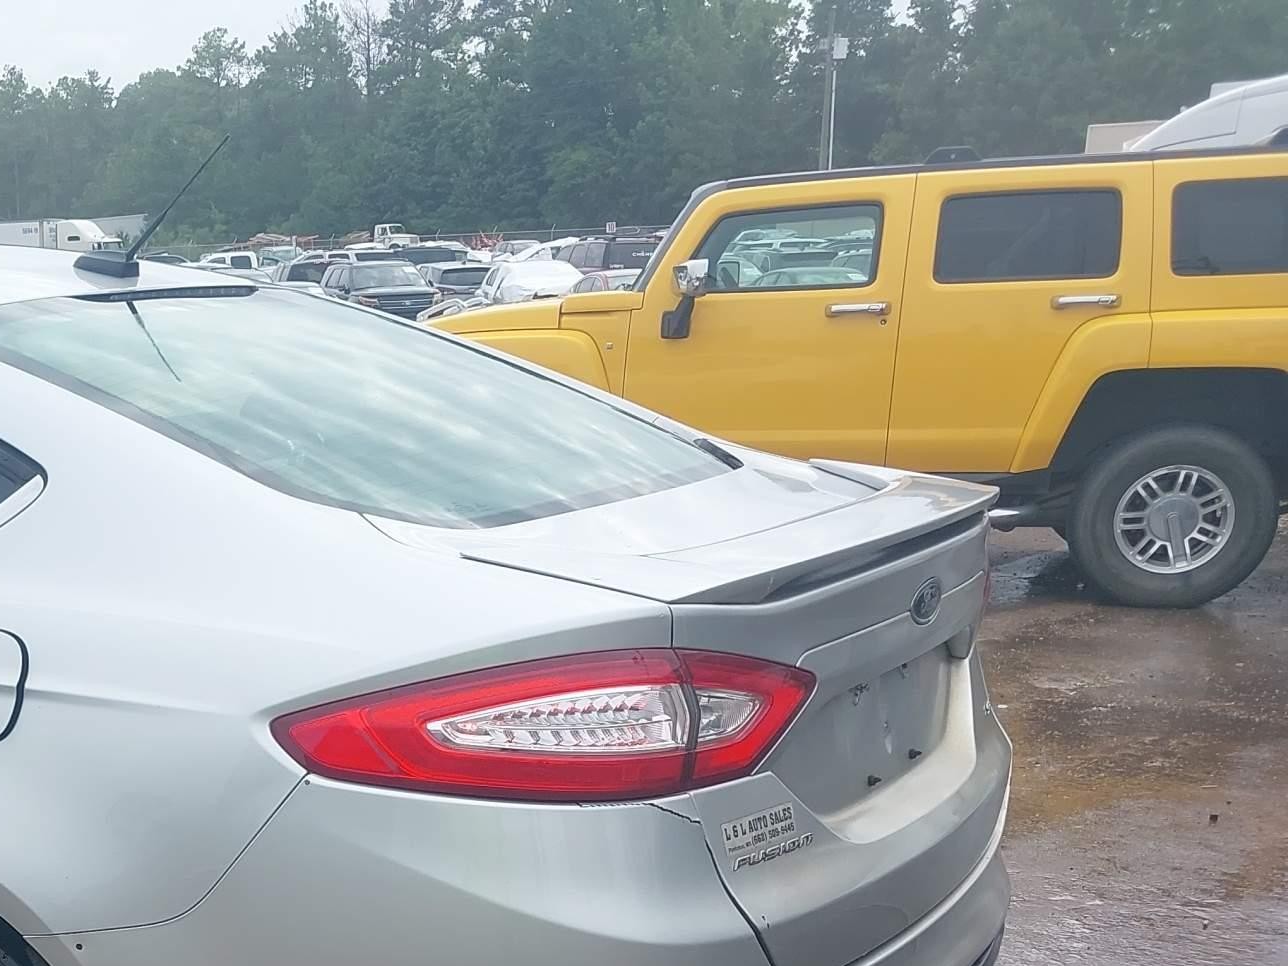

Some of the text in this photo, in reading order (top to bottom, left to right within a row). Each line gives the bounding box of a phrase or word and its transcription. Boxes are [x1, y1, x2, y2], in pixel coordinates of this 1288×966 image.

[724, 807, 793, 841] L & L AUTO SALES
[732, 832, 814, 872] FUSION
